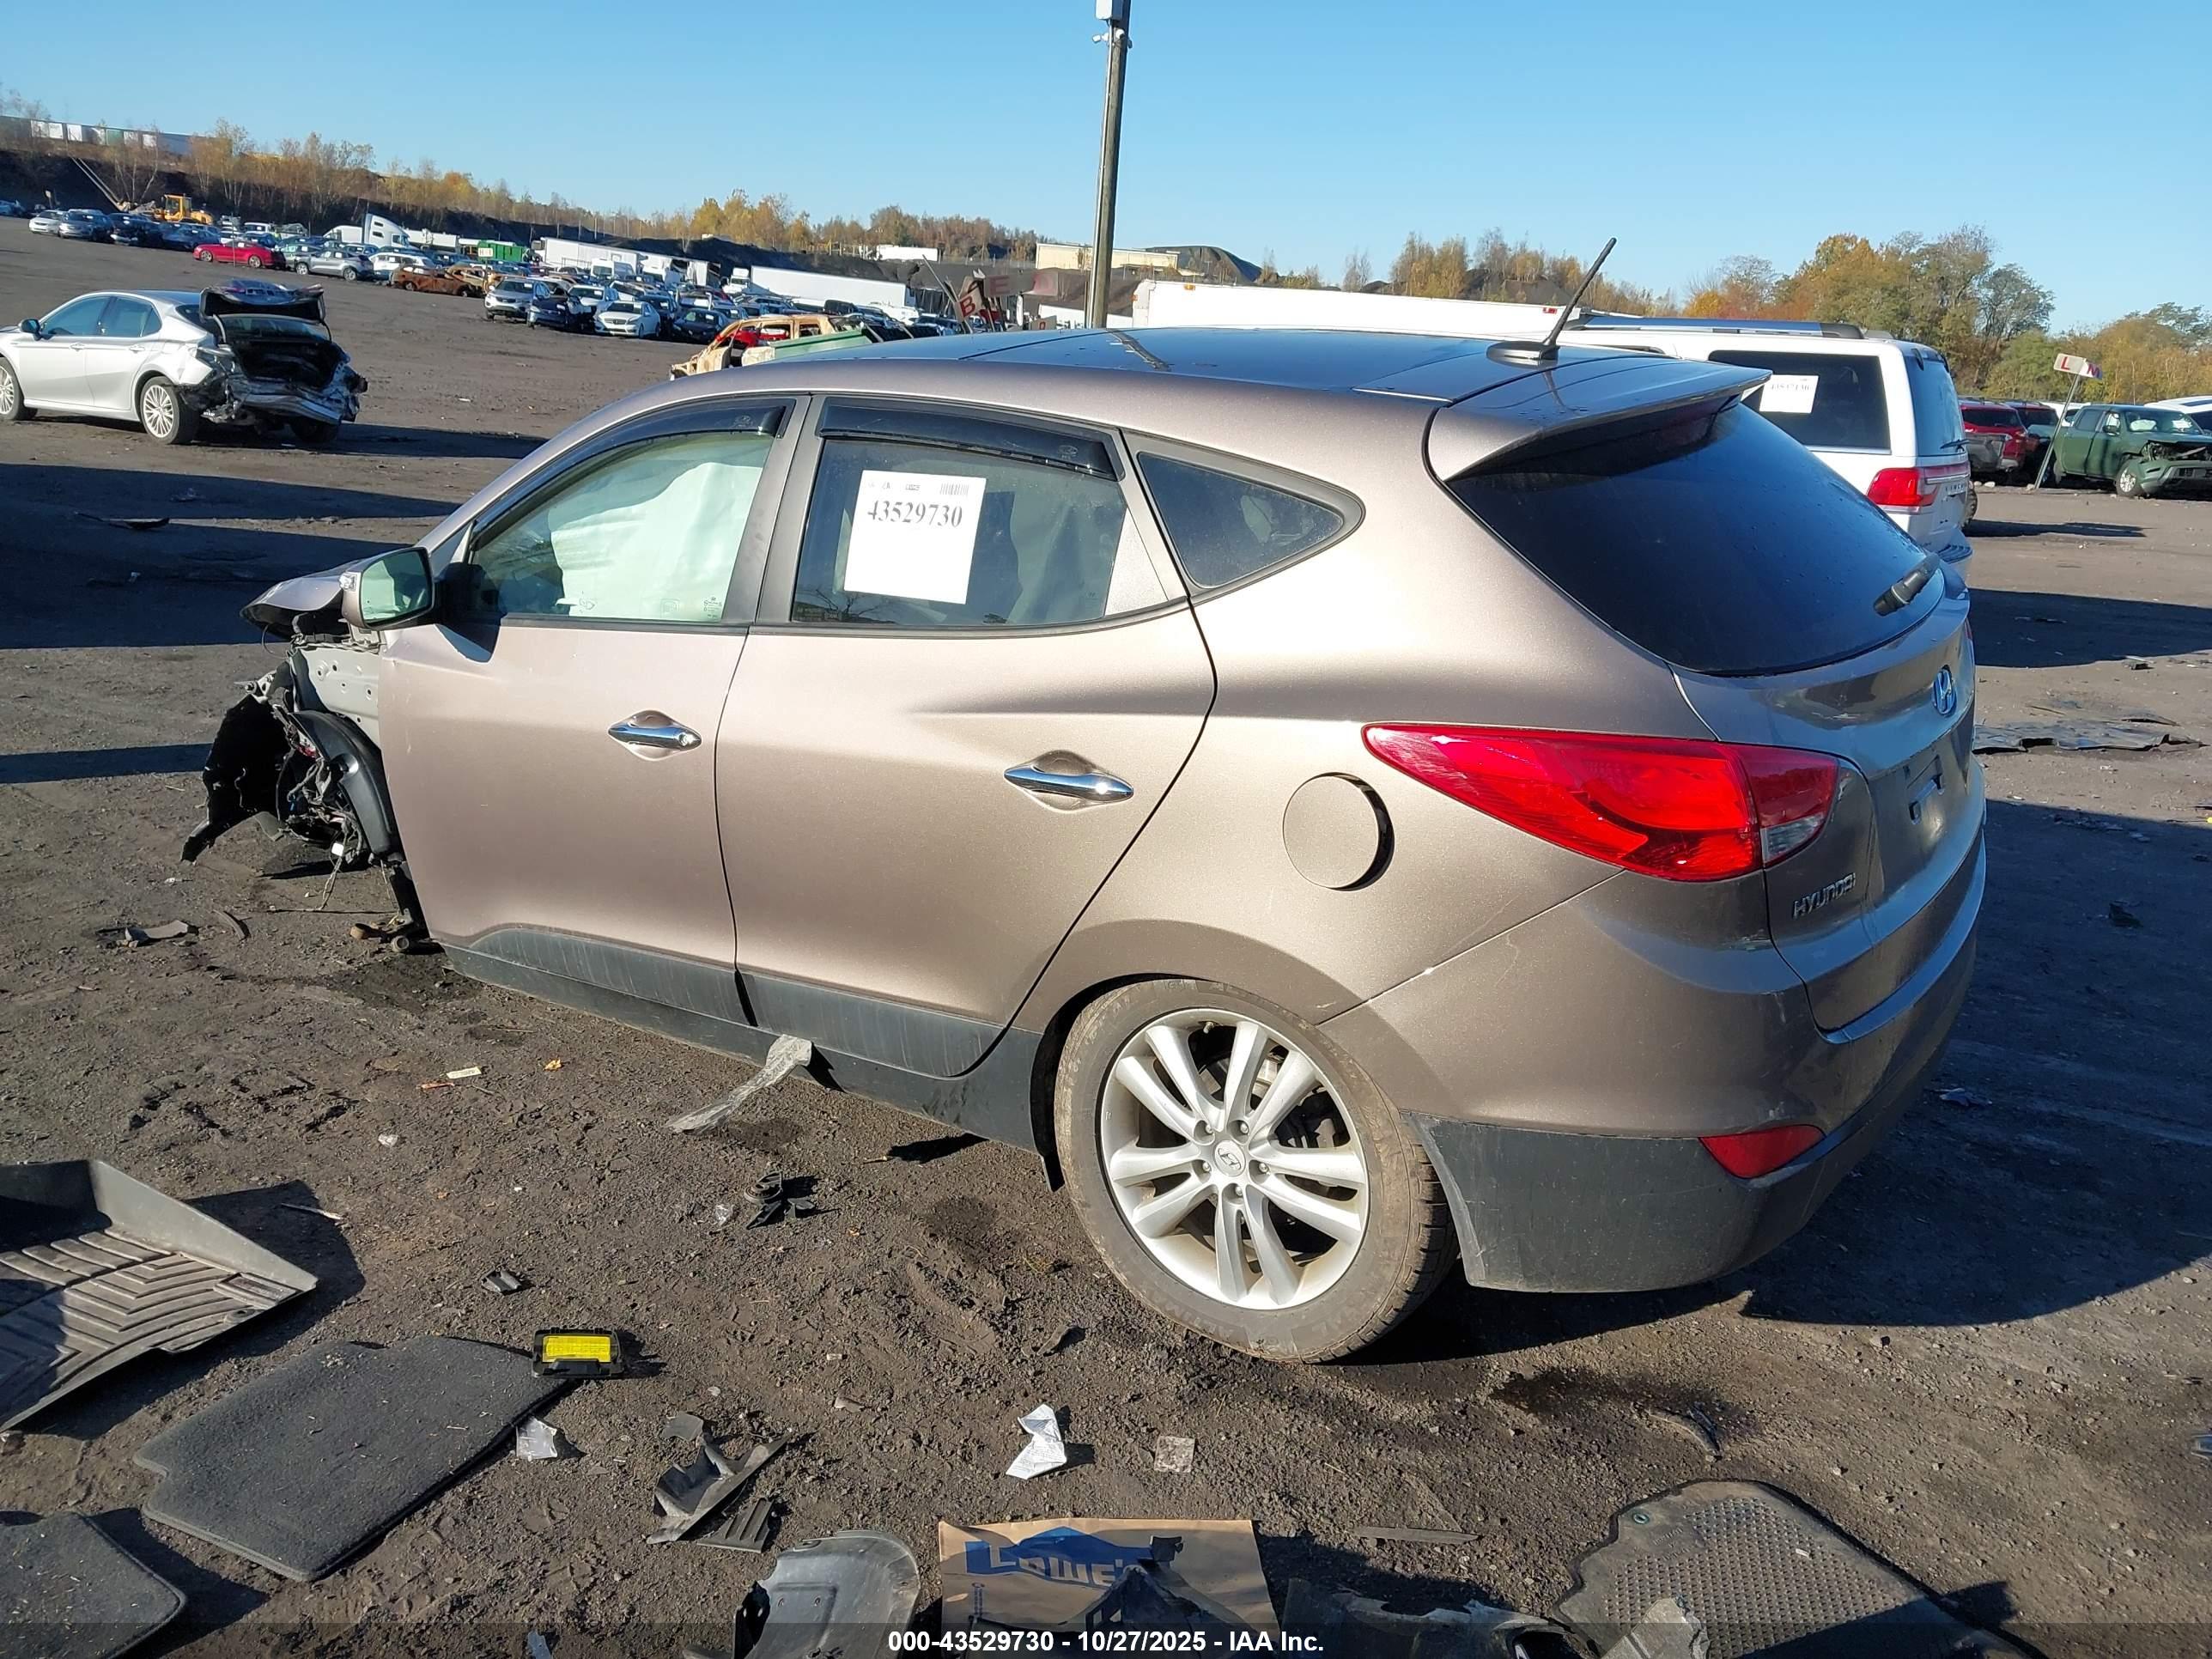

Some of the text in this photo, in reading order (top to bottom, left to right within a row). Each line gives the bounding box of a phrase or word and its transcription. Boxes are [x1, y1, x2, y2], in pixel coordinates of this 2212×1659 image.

[989, 274, 1011, 296] E
[960, 295, 975, 318] B
[2060, 356, 2101, 379] L M
[866, 500, 963, 528] 43529730
[1793, 872, 1856, 919] HYUNDAI
[988, 1544, 1120, 1588] LOWE'
